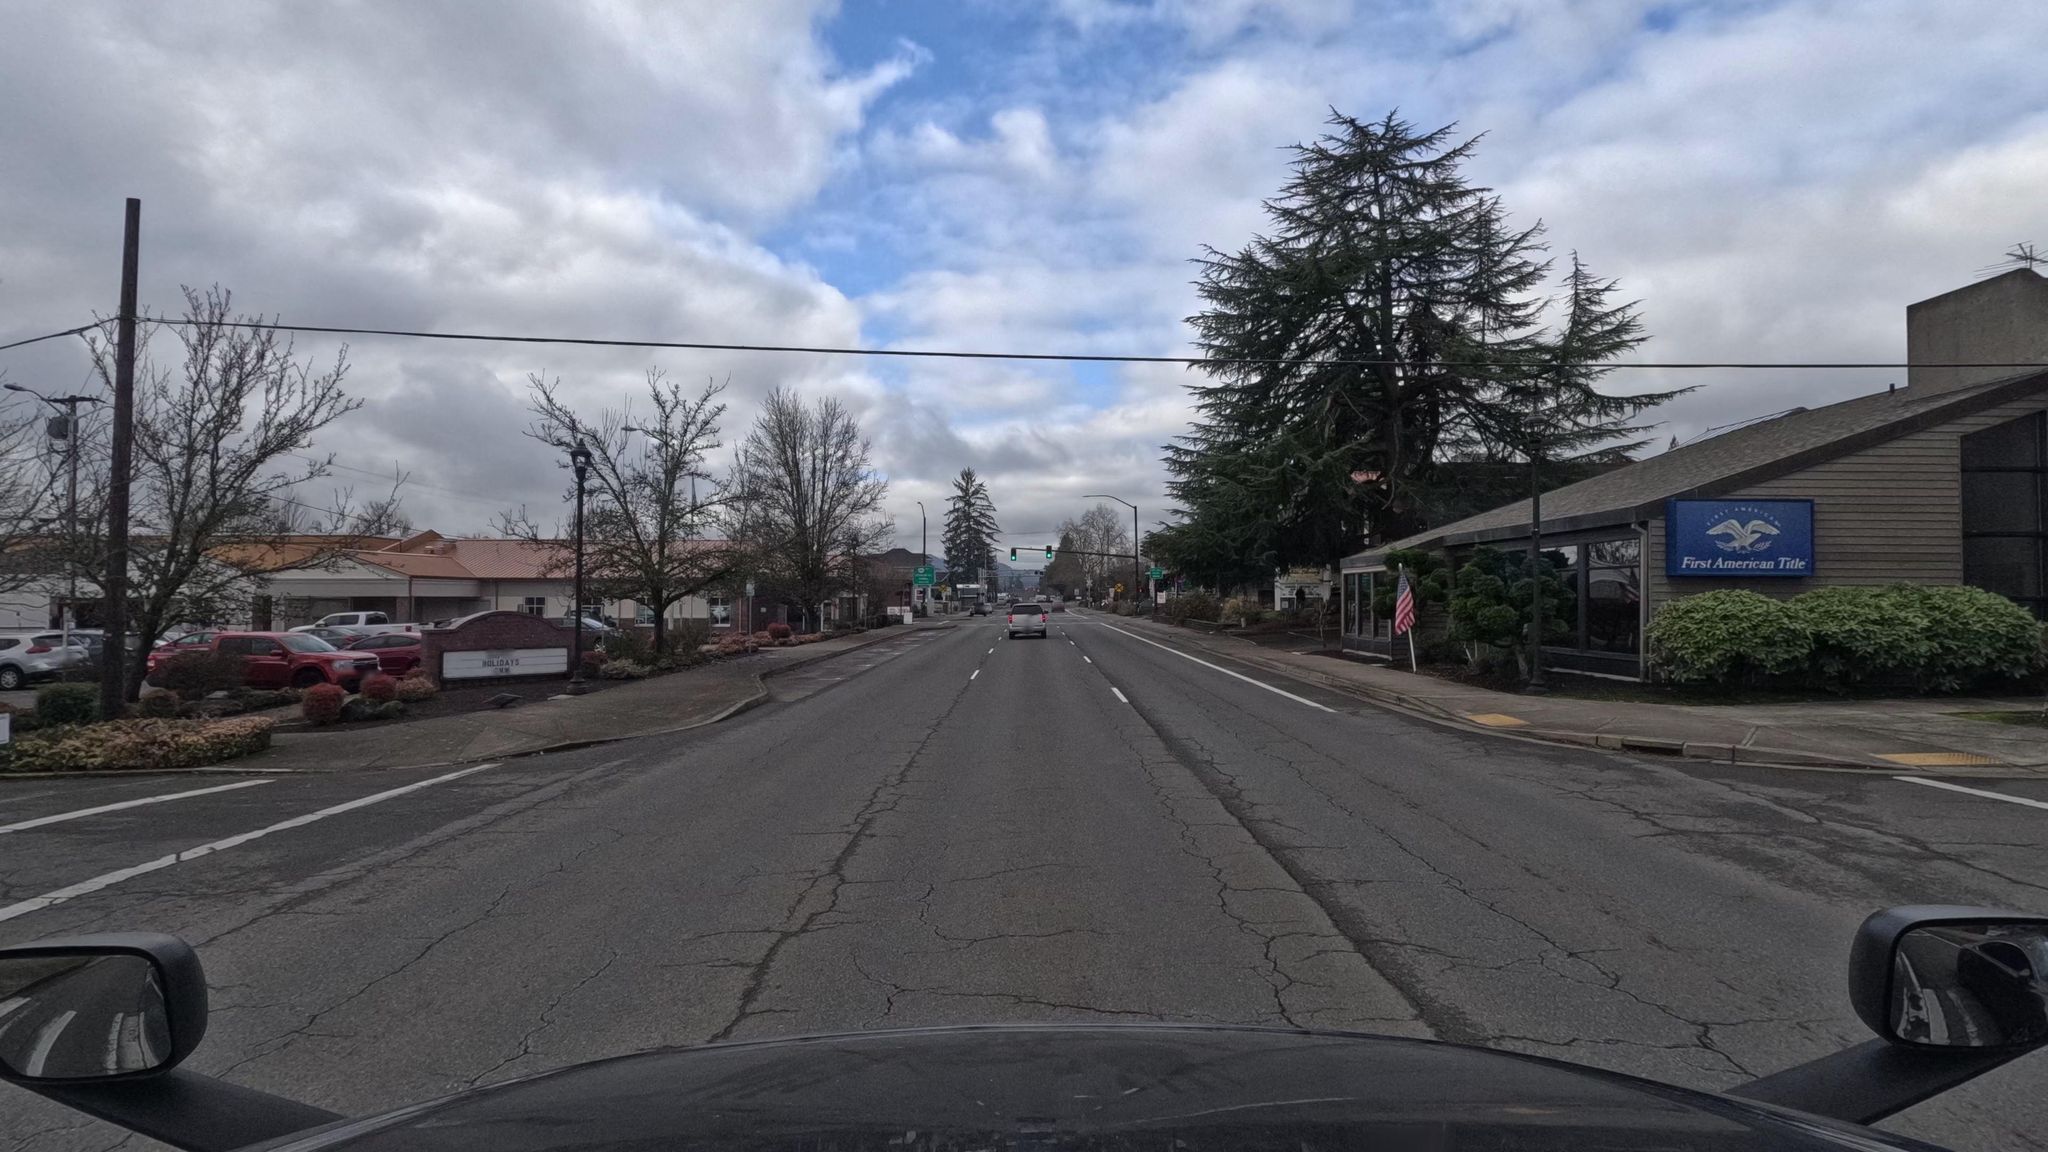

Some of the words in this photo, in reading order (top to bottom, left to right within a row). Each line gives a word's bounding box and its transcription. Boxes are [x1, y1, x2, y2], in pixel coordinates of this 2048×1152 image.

[1681, 556, 1712, 569] First
[1713, 556, 1774, 569] American
[1778, 556, 1806, 569] Title
